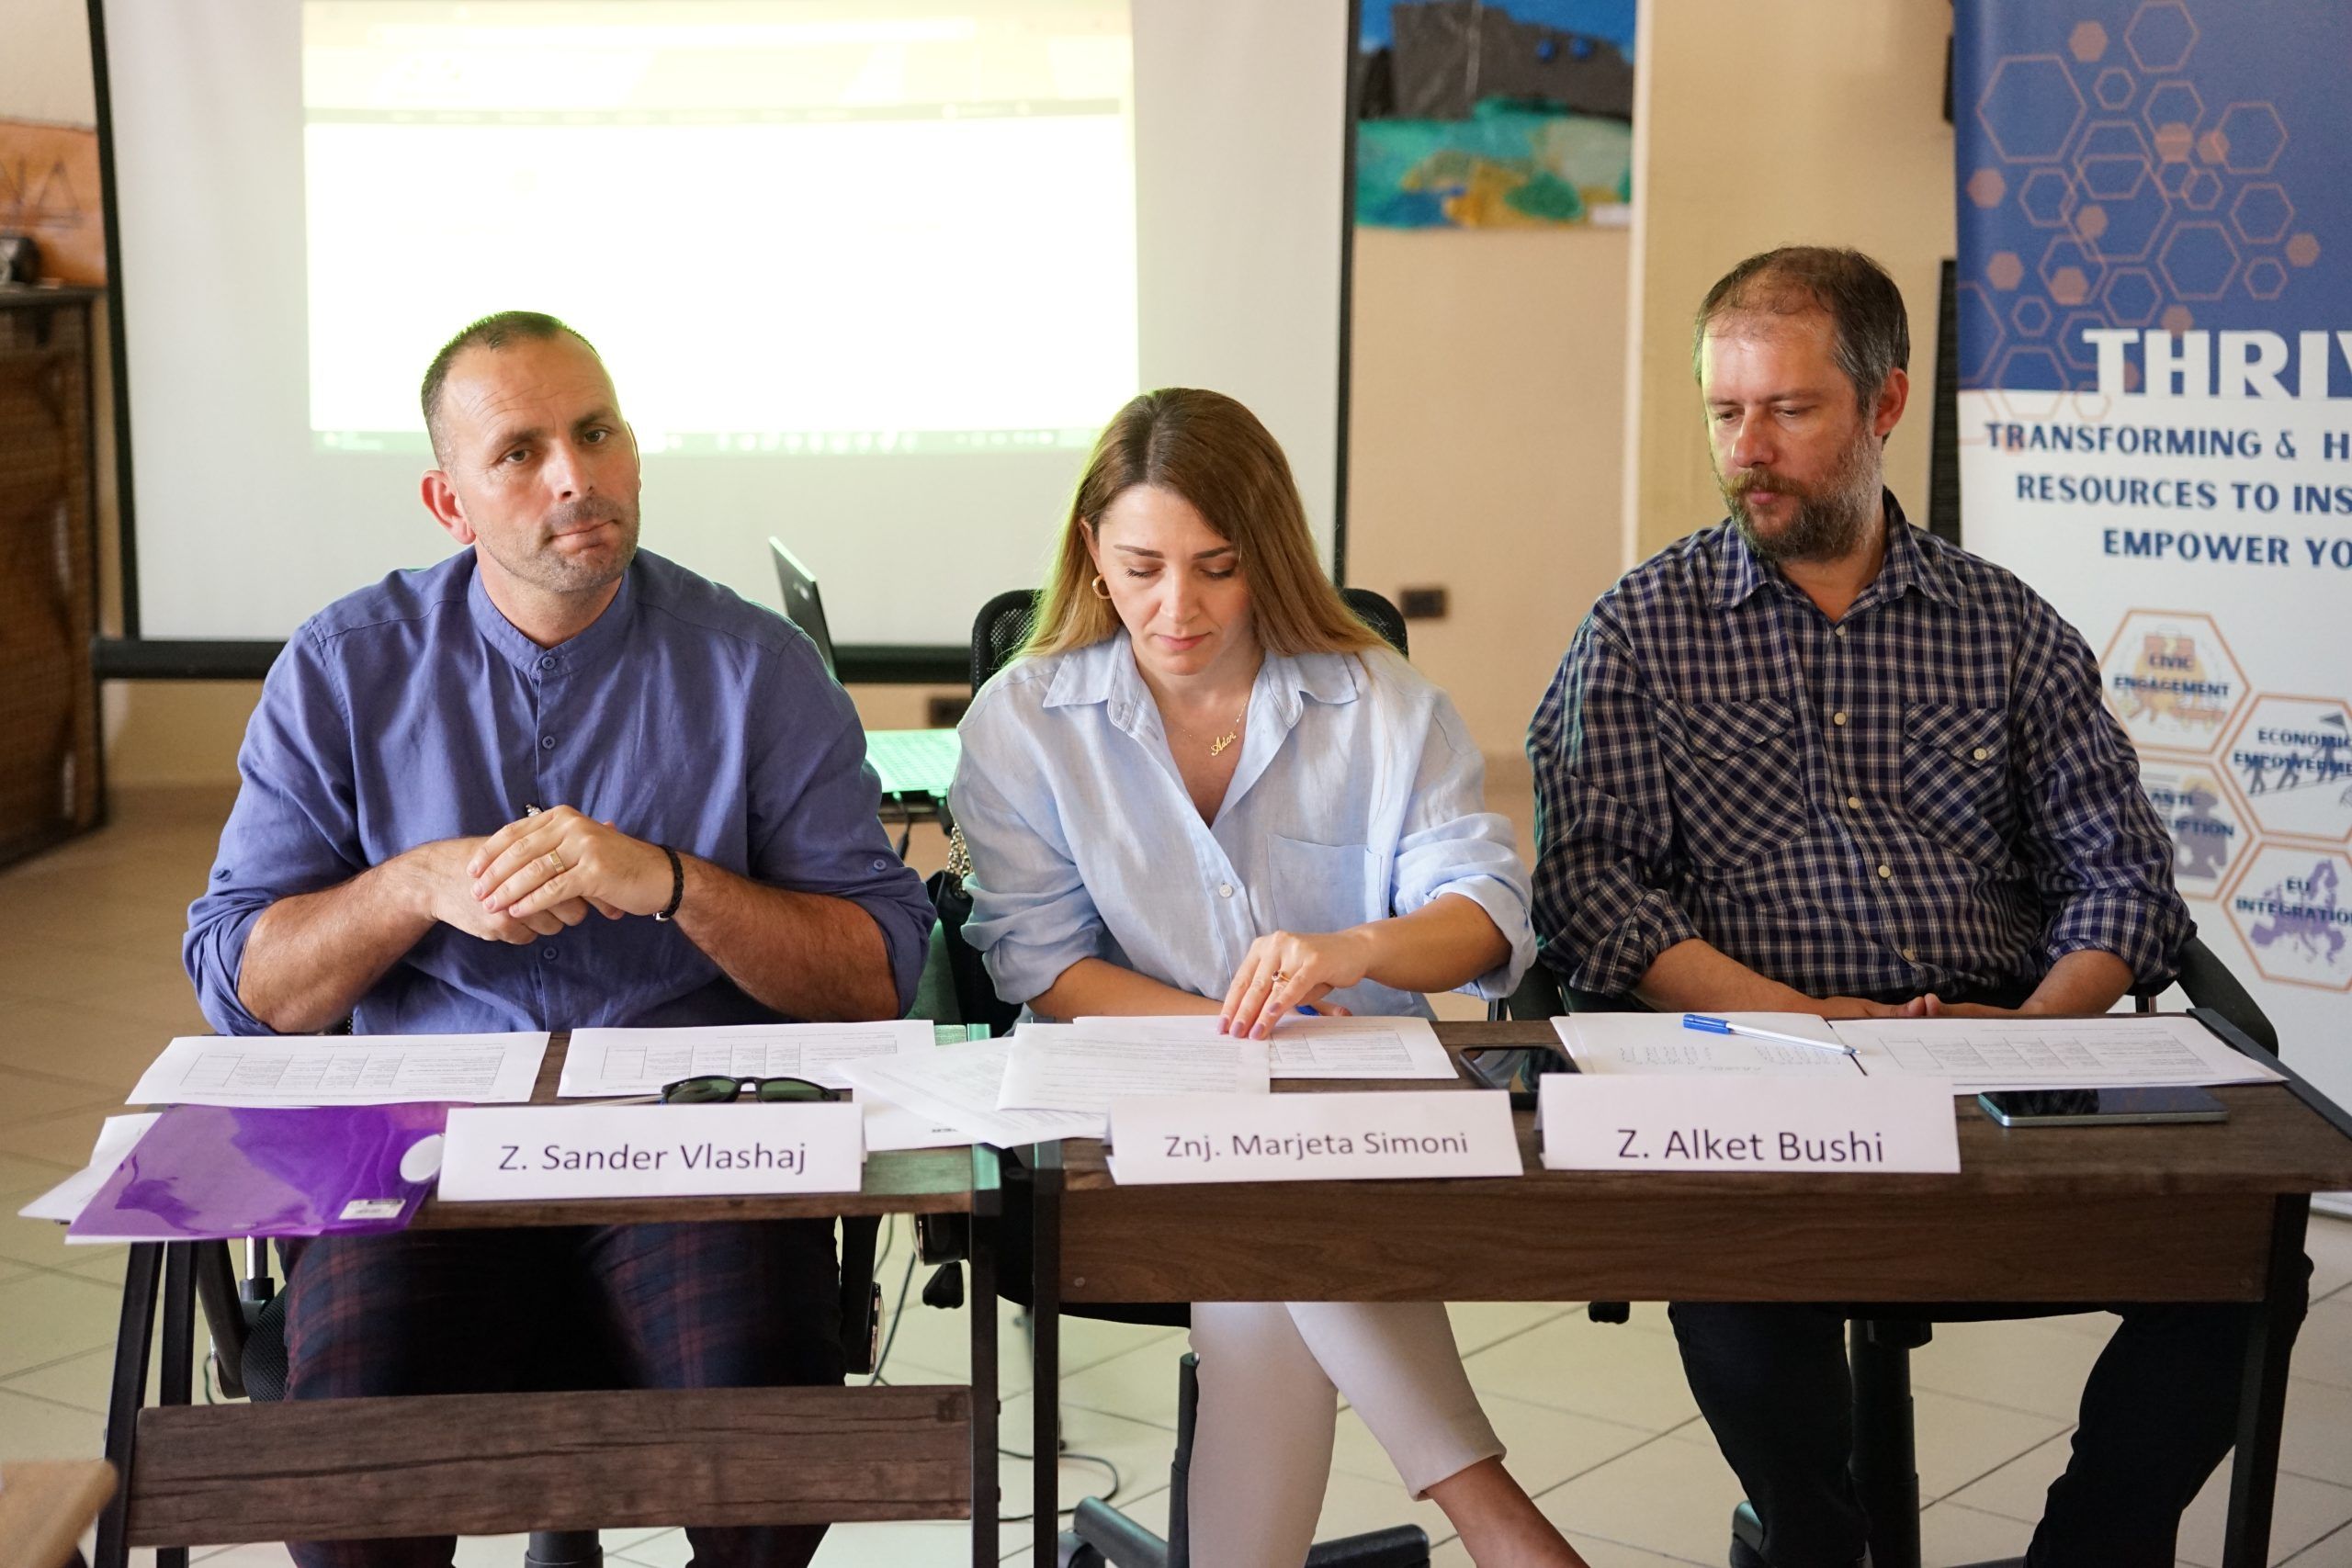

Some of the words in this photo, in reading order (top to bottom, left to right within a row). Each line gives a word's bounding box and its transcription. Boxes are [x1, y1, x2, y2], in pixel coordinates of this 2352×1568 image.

[2083, 328, 2352, 400] THRI
[1984, 422, 2262, 458] TRANSFORMING
[2275, 430, 2297, 459] &
[2323, 432, 2352, 460] H
[2017, 474, 2218, 510] RESOURCES
[2231, 482, 2279, 513] TO
[2293, 484, 2352, 514] INS
[2103, 529, 2290, 566] EMPOWER
[2304, 538, 2352, 570] YO
[2149, 654, 2194, 670] CIVIC
[2114, 676, 2230, 696] ENGAGEMENT
[2286, 878, 2312, 894] EU
[2235, 897, 2352, 924] INTEGRATIO
[498, 1145, 527, 1170] Z.
[542, 1143, 668, 1170] Sander
[680, 1142, 806, 1176] Vlashaj
[1164, 1134, 1221, 1163] Znj.
[1232, 1133, 1354, 1161] Marjeta
[1363, 1131, 1468, 1155] Simoni
[1617, 1129, 1649, 1158] Z.
[1664, 1128, 1764, 1161] Alket
[1779, 1130, 1883, 1163] Bushi
